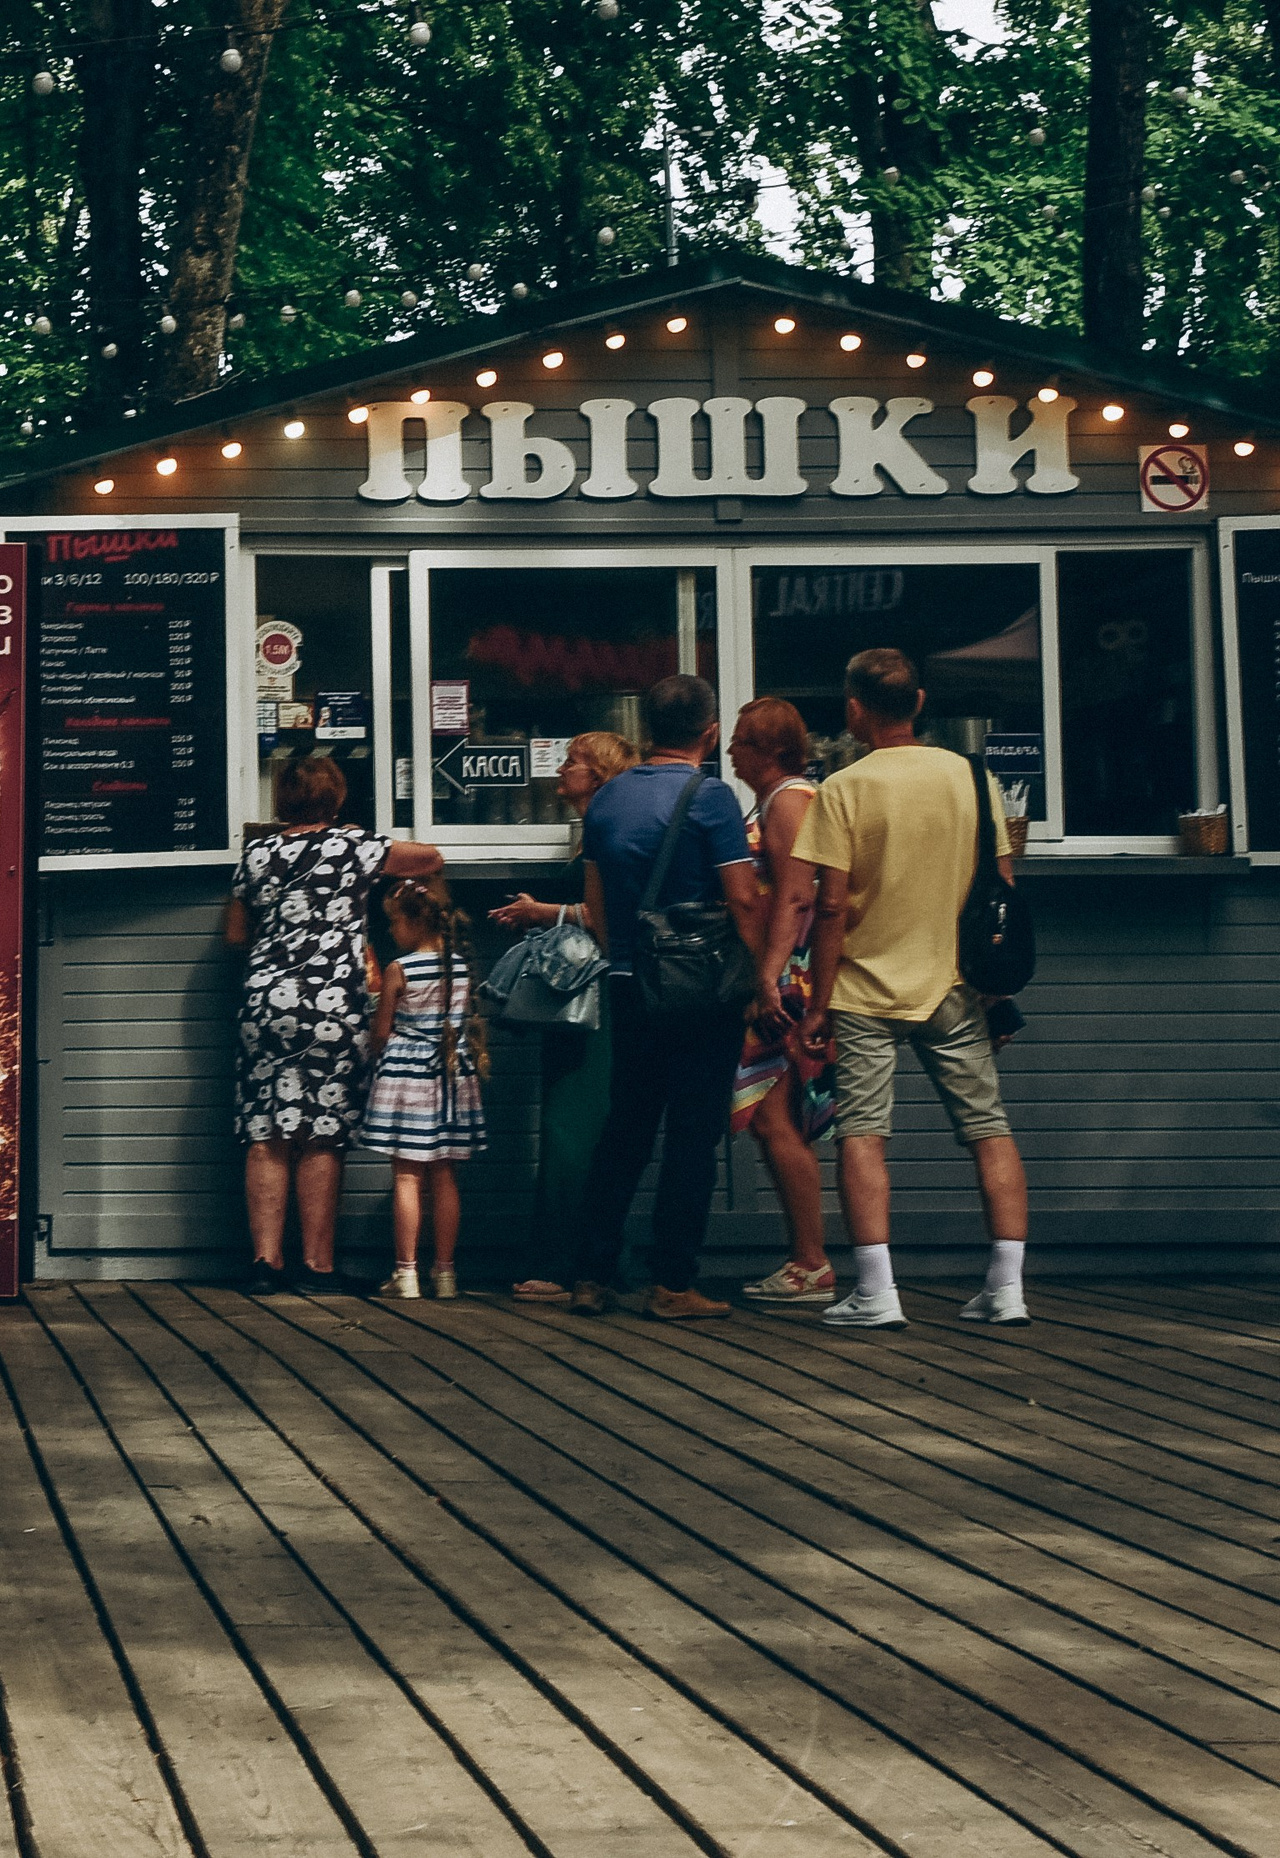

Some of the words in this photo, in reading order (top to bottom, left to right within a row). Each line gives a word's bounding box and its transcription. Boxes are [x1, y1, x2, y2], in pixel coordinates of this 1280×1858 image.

[357, 395, 1081, 502] ПЫШКИ
[46, 531, 179, 562] Пышки
[462, 755, 522, 778] КАССА
